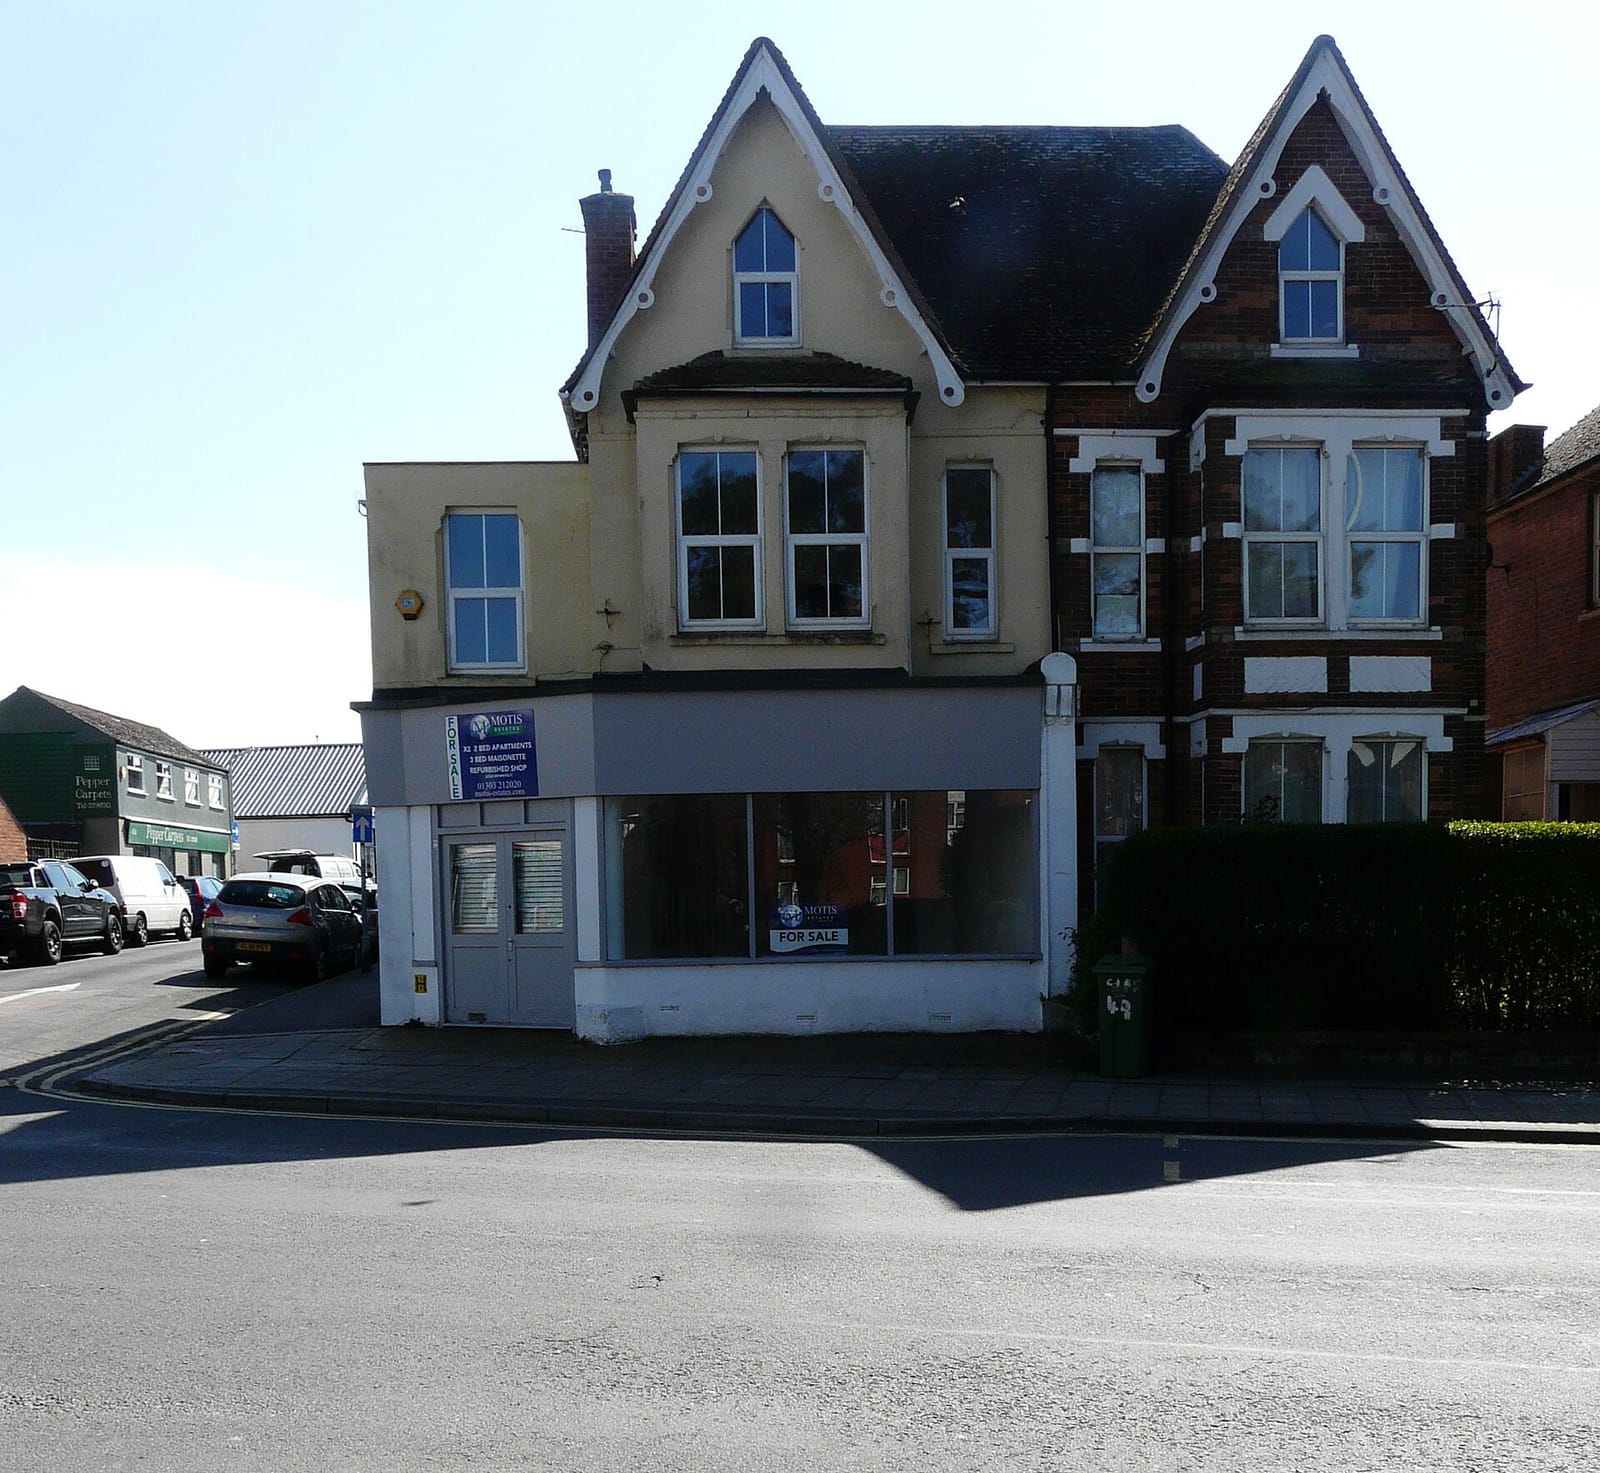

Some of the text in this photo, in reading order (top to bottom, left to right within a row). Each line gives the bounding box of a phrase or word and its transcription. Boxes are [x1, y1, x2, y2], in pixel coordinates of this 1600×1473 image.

[491, 714, 523, 726] MOTIS
[492, 741, 532, 751] APARTMENTS
[447, 717, 460, 798] FOR SALE
[510, 764, 527, 772] SHOP
[75, 776, 111, 789] Pepper
[75, 789, 112, 801] Carpets
[804, 905, 838, 915] MOTIS
[779, 931, 839, 942] FOR SALE
